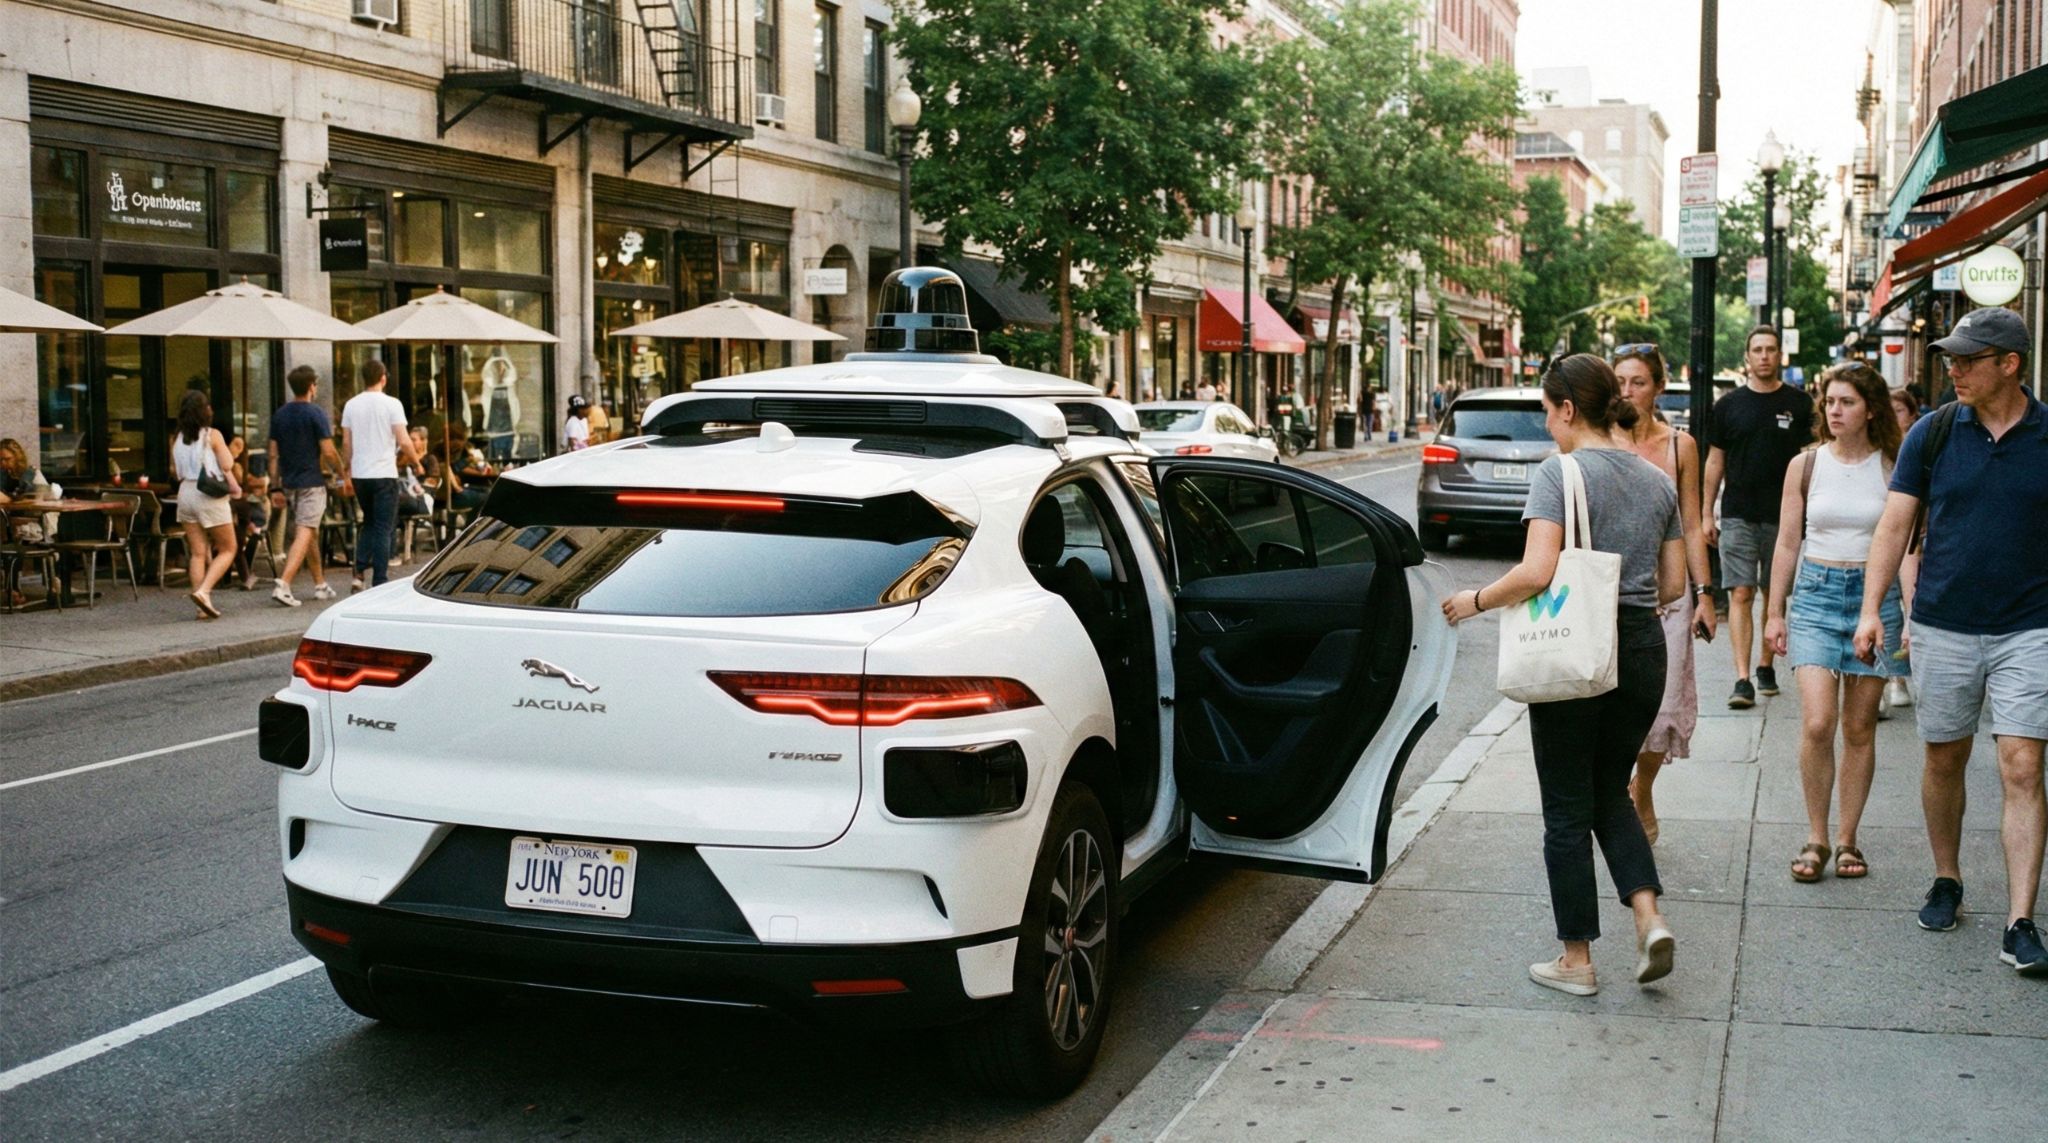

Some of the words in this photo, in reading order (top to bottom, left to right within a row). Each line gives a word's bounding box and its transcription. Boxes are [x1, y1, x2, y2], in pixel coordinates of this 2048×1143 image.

[1519, 627, 1571, 643] WAYMO
[512, 697, 607, 713] JAGUAR
[570, 846, 600, 860] YORK
[515, 858, 563, 895] JUN
